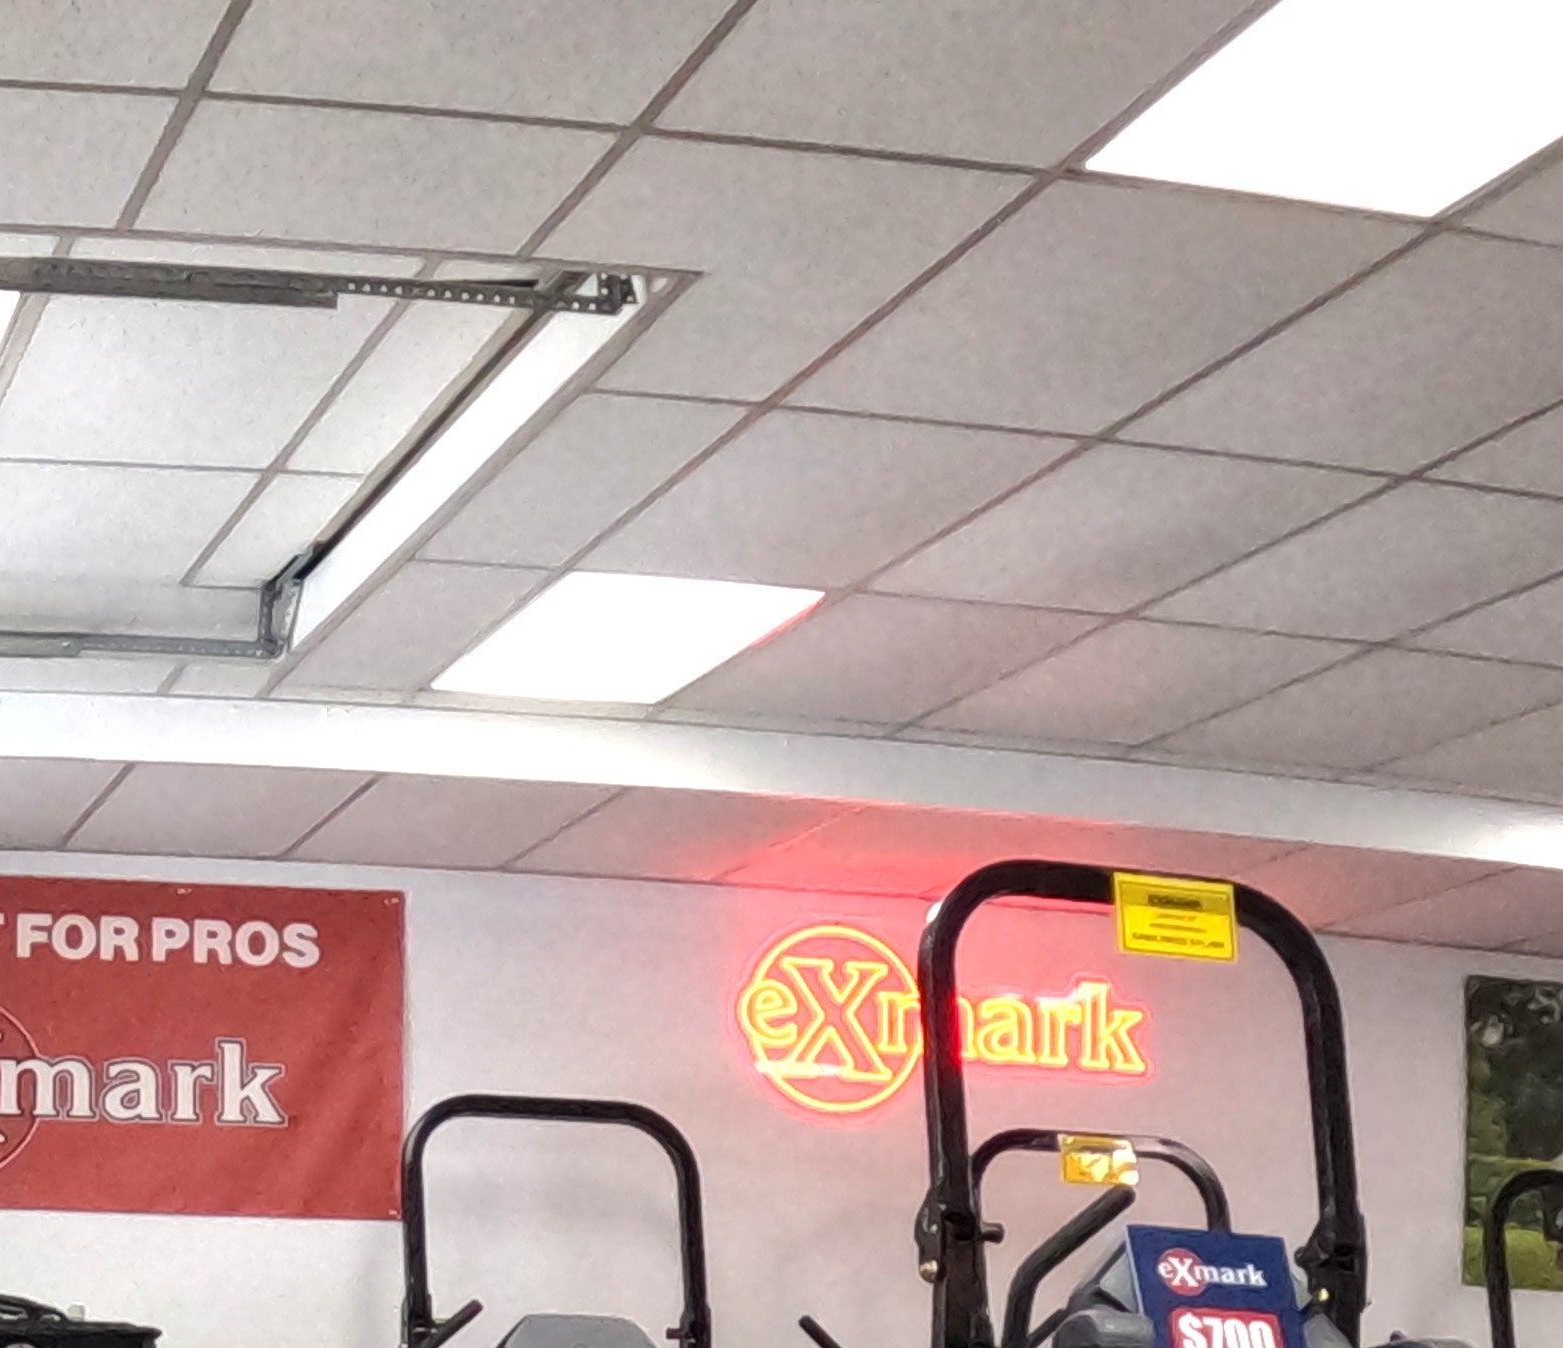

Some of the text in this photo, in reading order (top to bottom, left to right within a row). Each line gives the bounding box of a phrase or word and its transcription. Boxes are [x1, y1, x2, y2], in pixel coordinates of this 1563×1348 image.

[15, 912, 140, 962] FOR
[151, 917, 321, 969] PROS
[1158, 1256, 1268, 1288] eXmark
